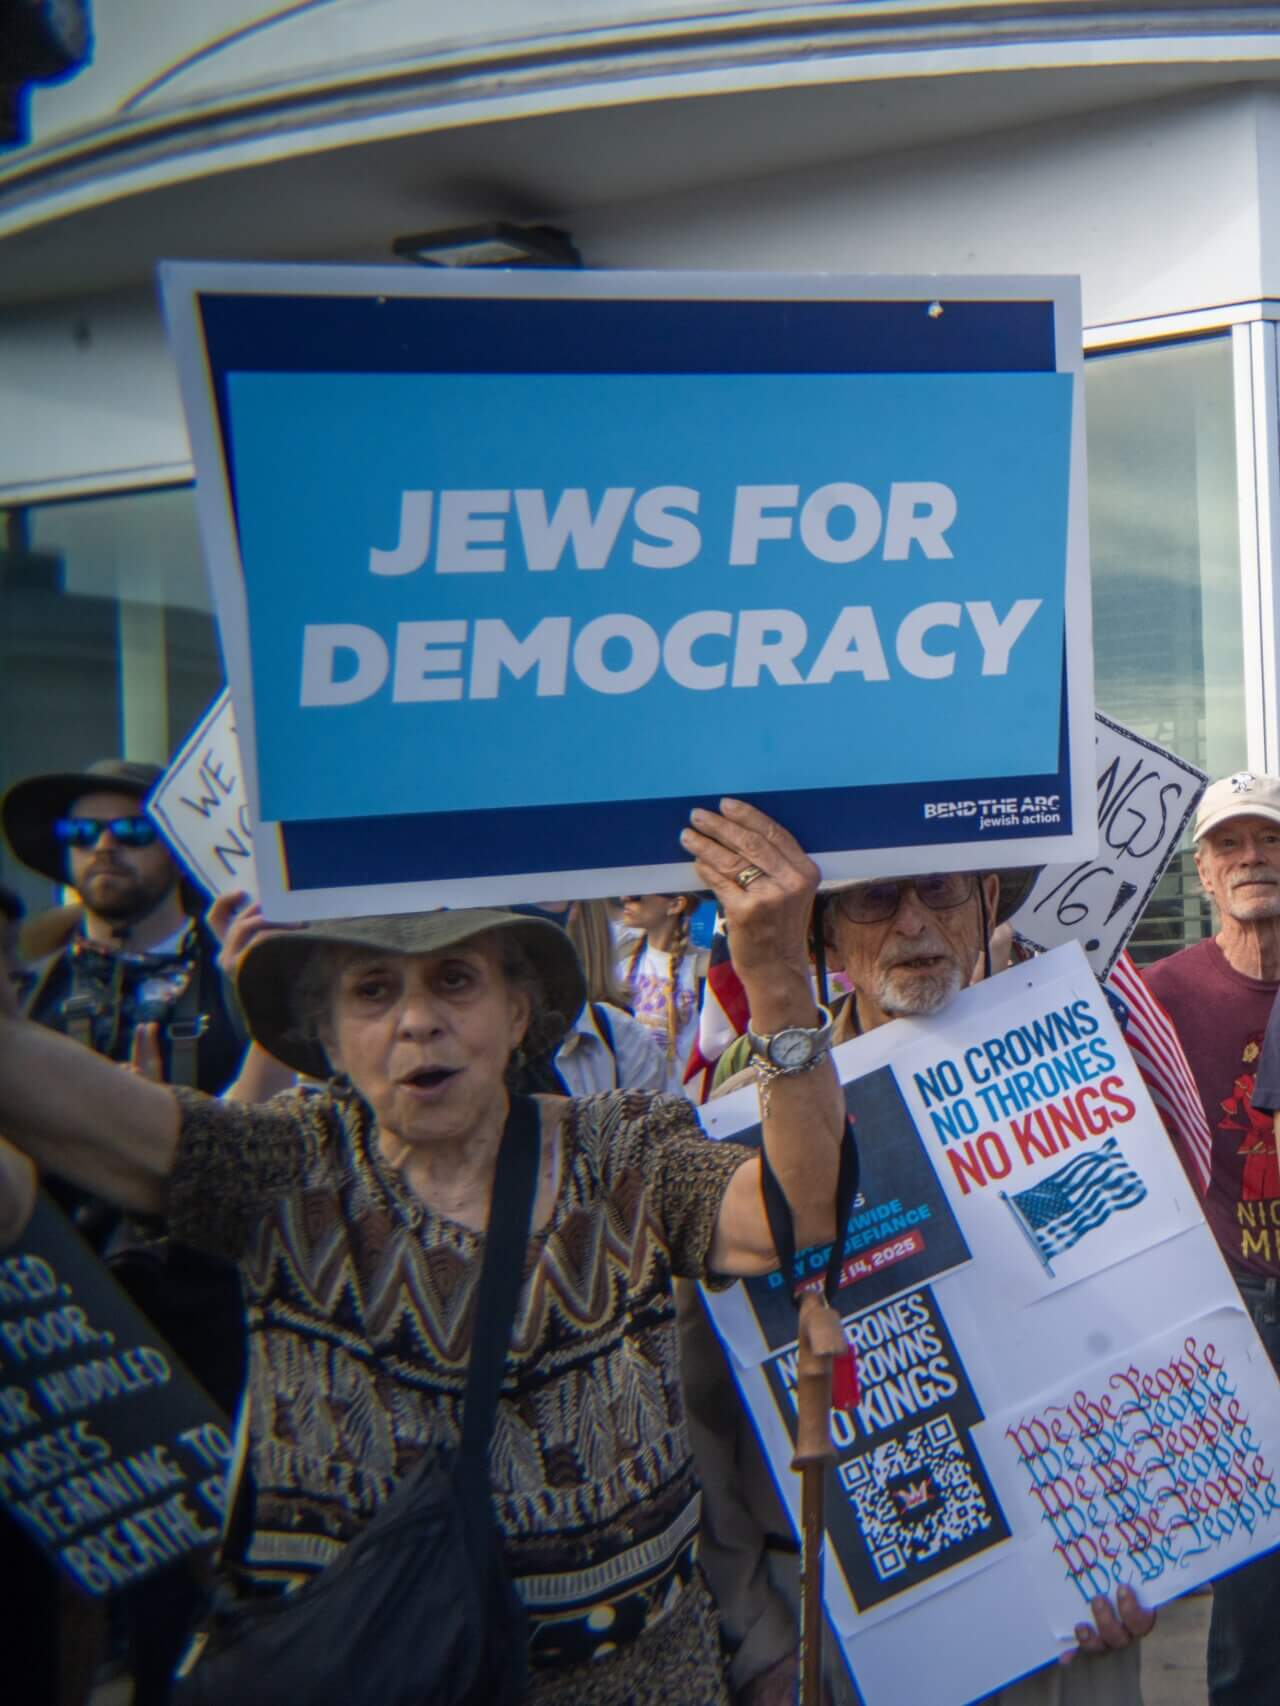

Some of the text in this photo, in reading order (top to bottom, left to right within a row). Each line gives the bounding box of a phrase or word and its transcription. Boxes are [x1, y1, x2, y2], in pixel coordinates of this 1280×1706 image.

[369, 481, 958, 578] JEWS FOR
[299, 598, 1043, 709] DEMOCRACY
[179, 749, 236, 818] WE
[924, 795, 1060, 819] BEND THE ARC
[979, 812, 1061, 830] jewish action
[913, 1000, 1099, 1108] NO CROWNS
[929, 1037, 1116, 1146] NO THRONES
[946, 1075, 1136, 1195] NO KINGS
[872, 1236, 916, 1267] 2025
[35, 1346, 172, 1416] HUDDLED
[856, 1356, 959, 1436] KINGS
[1109, 1337, 1226, 1426] People
[1121, 1366, 1238, 1455] People
[1133, 1394, 1250, 1483] People
[1145, 1423, 1262, 1512] People
[12, 1445, 187, 1546] YEARNING
[176, 1422, 235, 1471] TO
[1157, 1452, 1274, 1541] People
[58, 1493, 219, 1596] BREATHE
